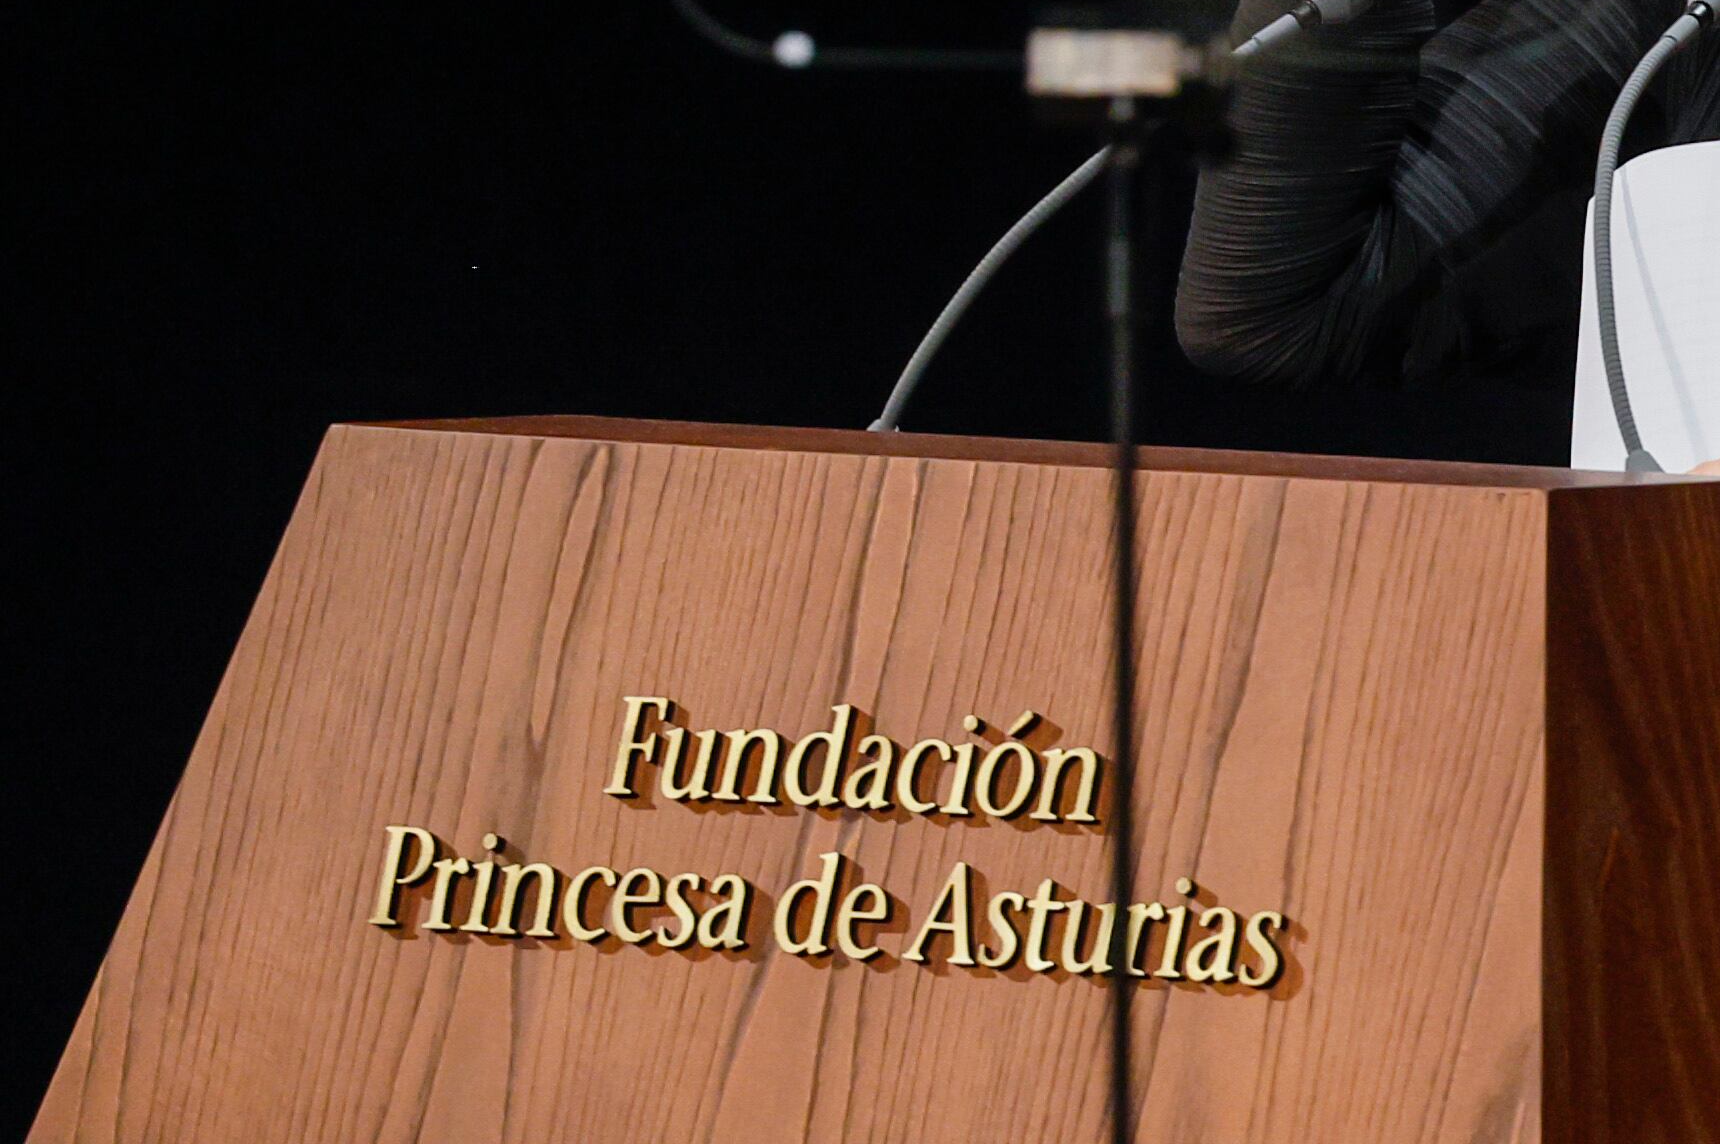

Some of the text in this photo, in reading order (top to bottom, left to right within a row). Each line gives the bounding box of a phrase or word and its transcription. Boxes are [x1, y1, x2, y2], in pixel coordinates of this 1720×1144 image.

[604, 695, 1098, 823] Fundación
[369, 825, 1284, 987] Princesa de Asturias
